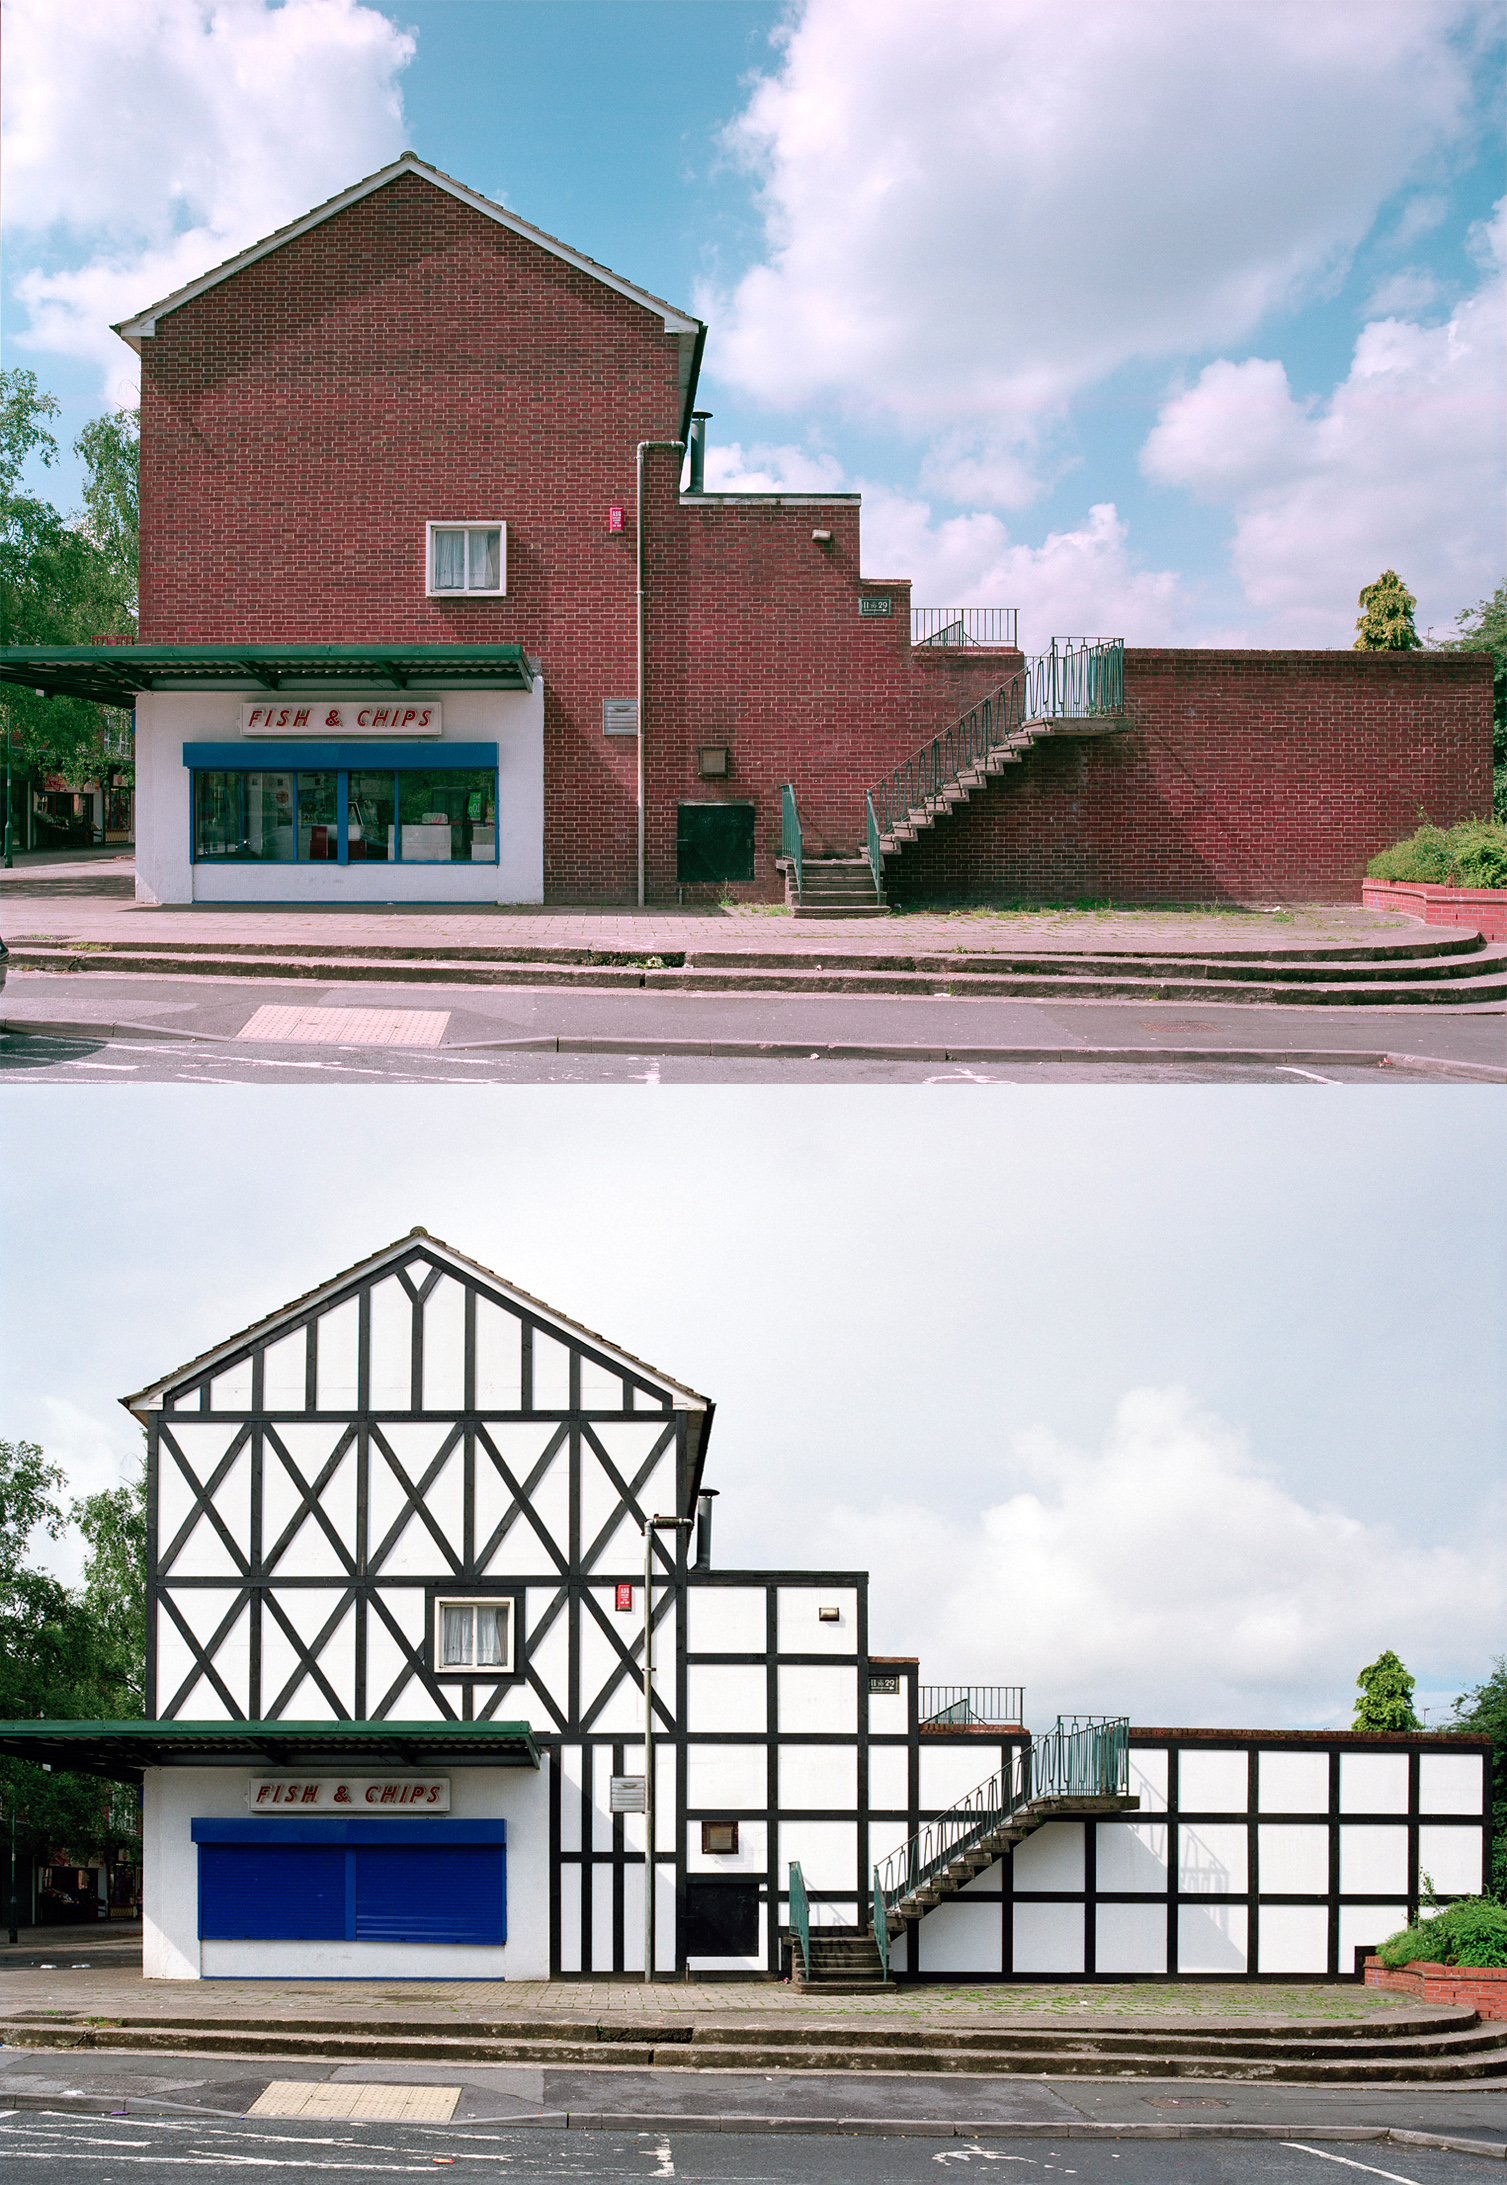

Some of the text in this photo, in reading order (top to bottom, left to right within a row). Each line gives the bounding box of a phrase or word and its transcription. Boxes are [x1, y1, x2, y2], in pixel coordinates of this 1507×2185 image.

[247, 709, 432, 727] FISH & CHIPS
[255, 1785, 441, 1803] FISH & CHIPS
